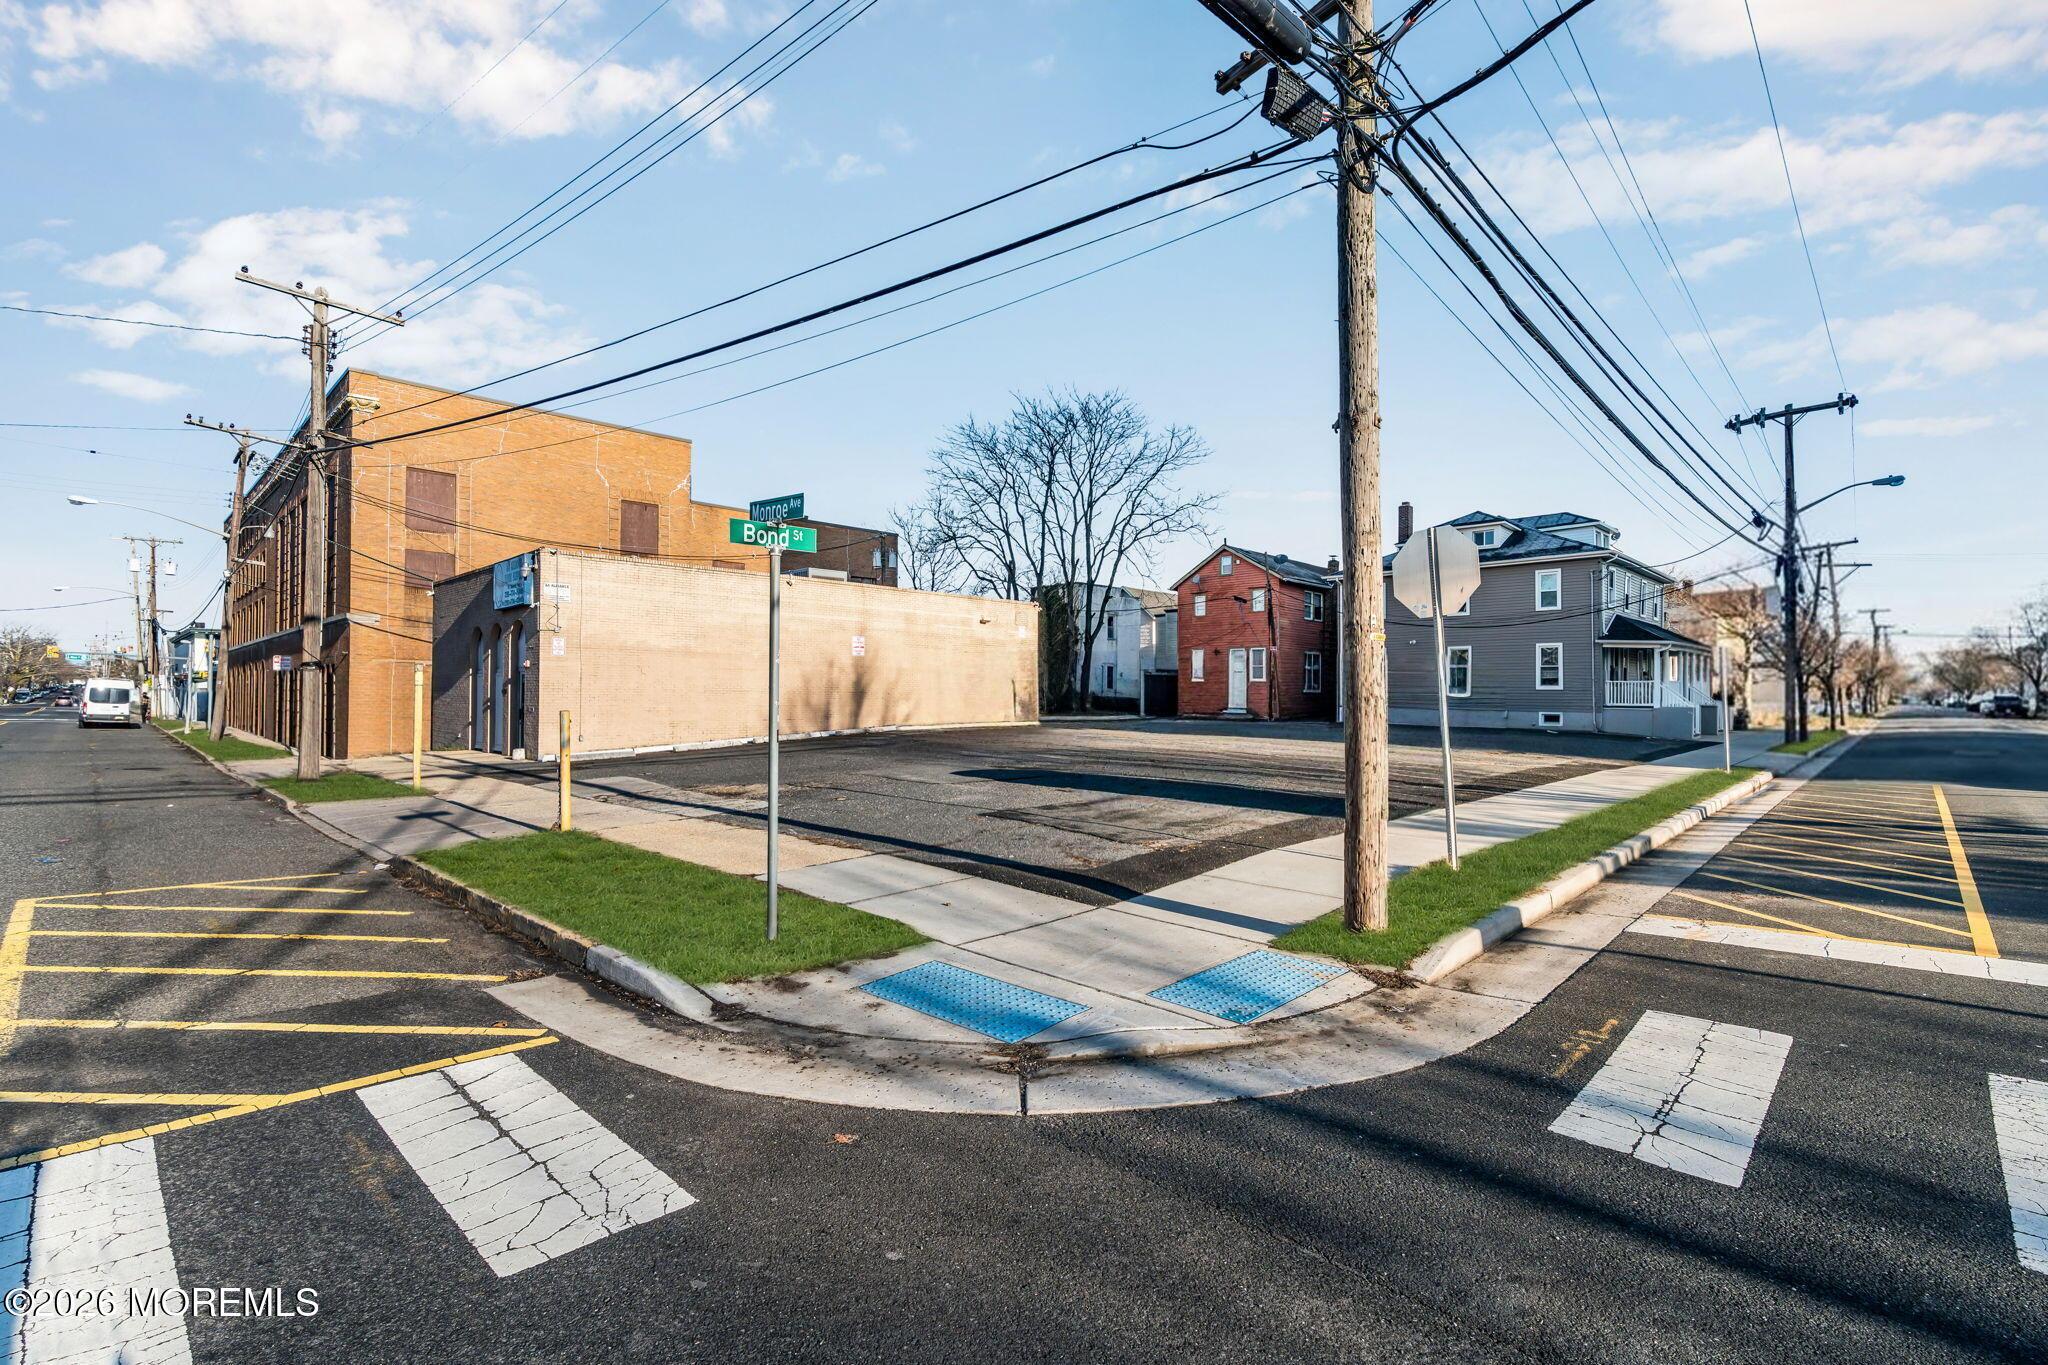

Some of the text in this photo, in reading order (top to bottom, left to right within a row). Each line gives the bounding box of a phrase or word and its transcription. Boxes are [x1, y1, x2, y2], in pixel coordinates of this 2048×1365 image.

[752, 498, 801, 522] Monroe Ave
[743, 523, 804, 547] Bond St
